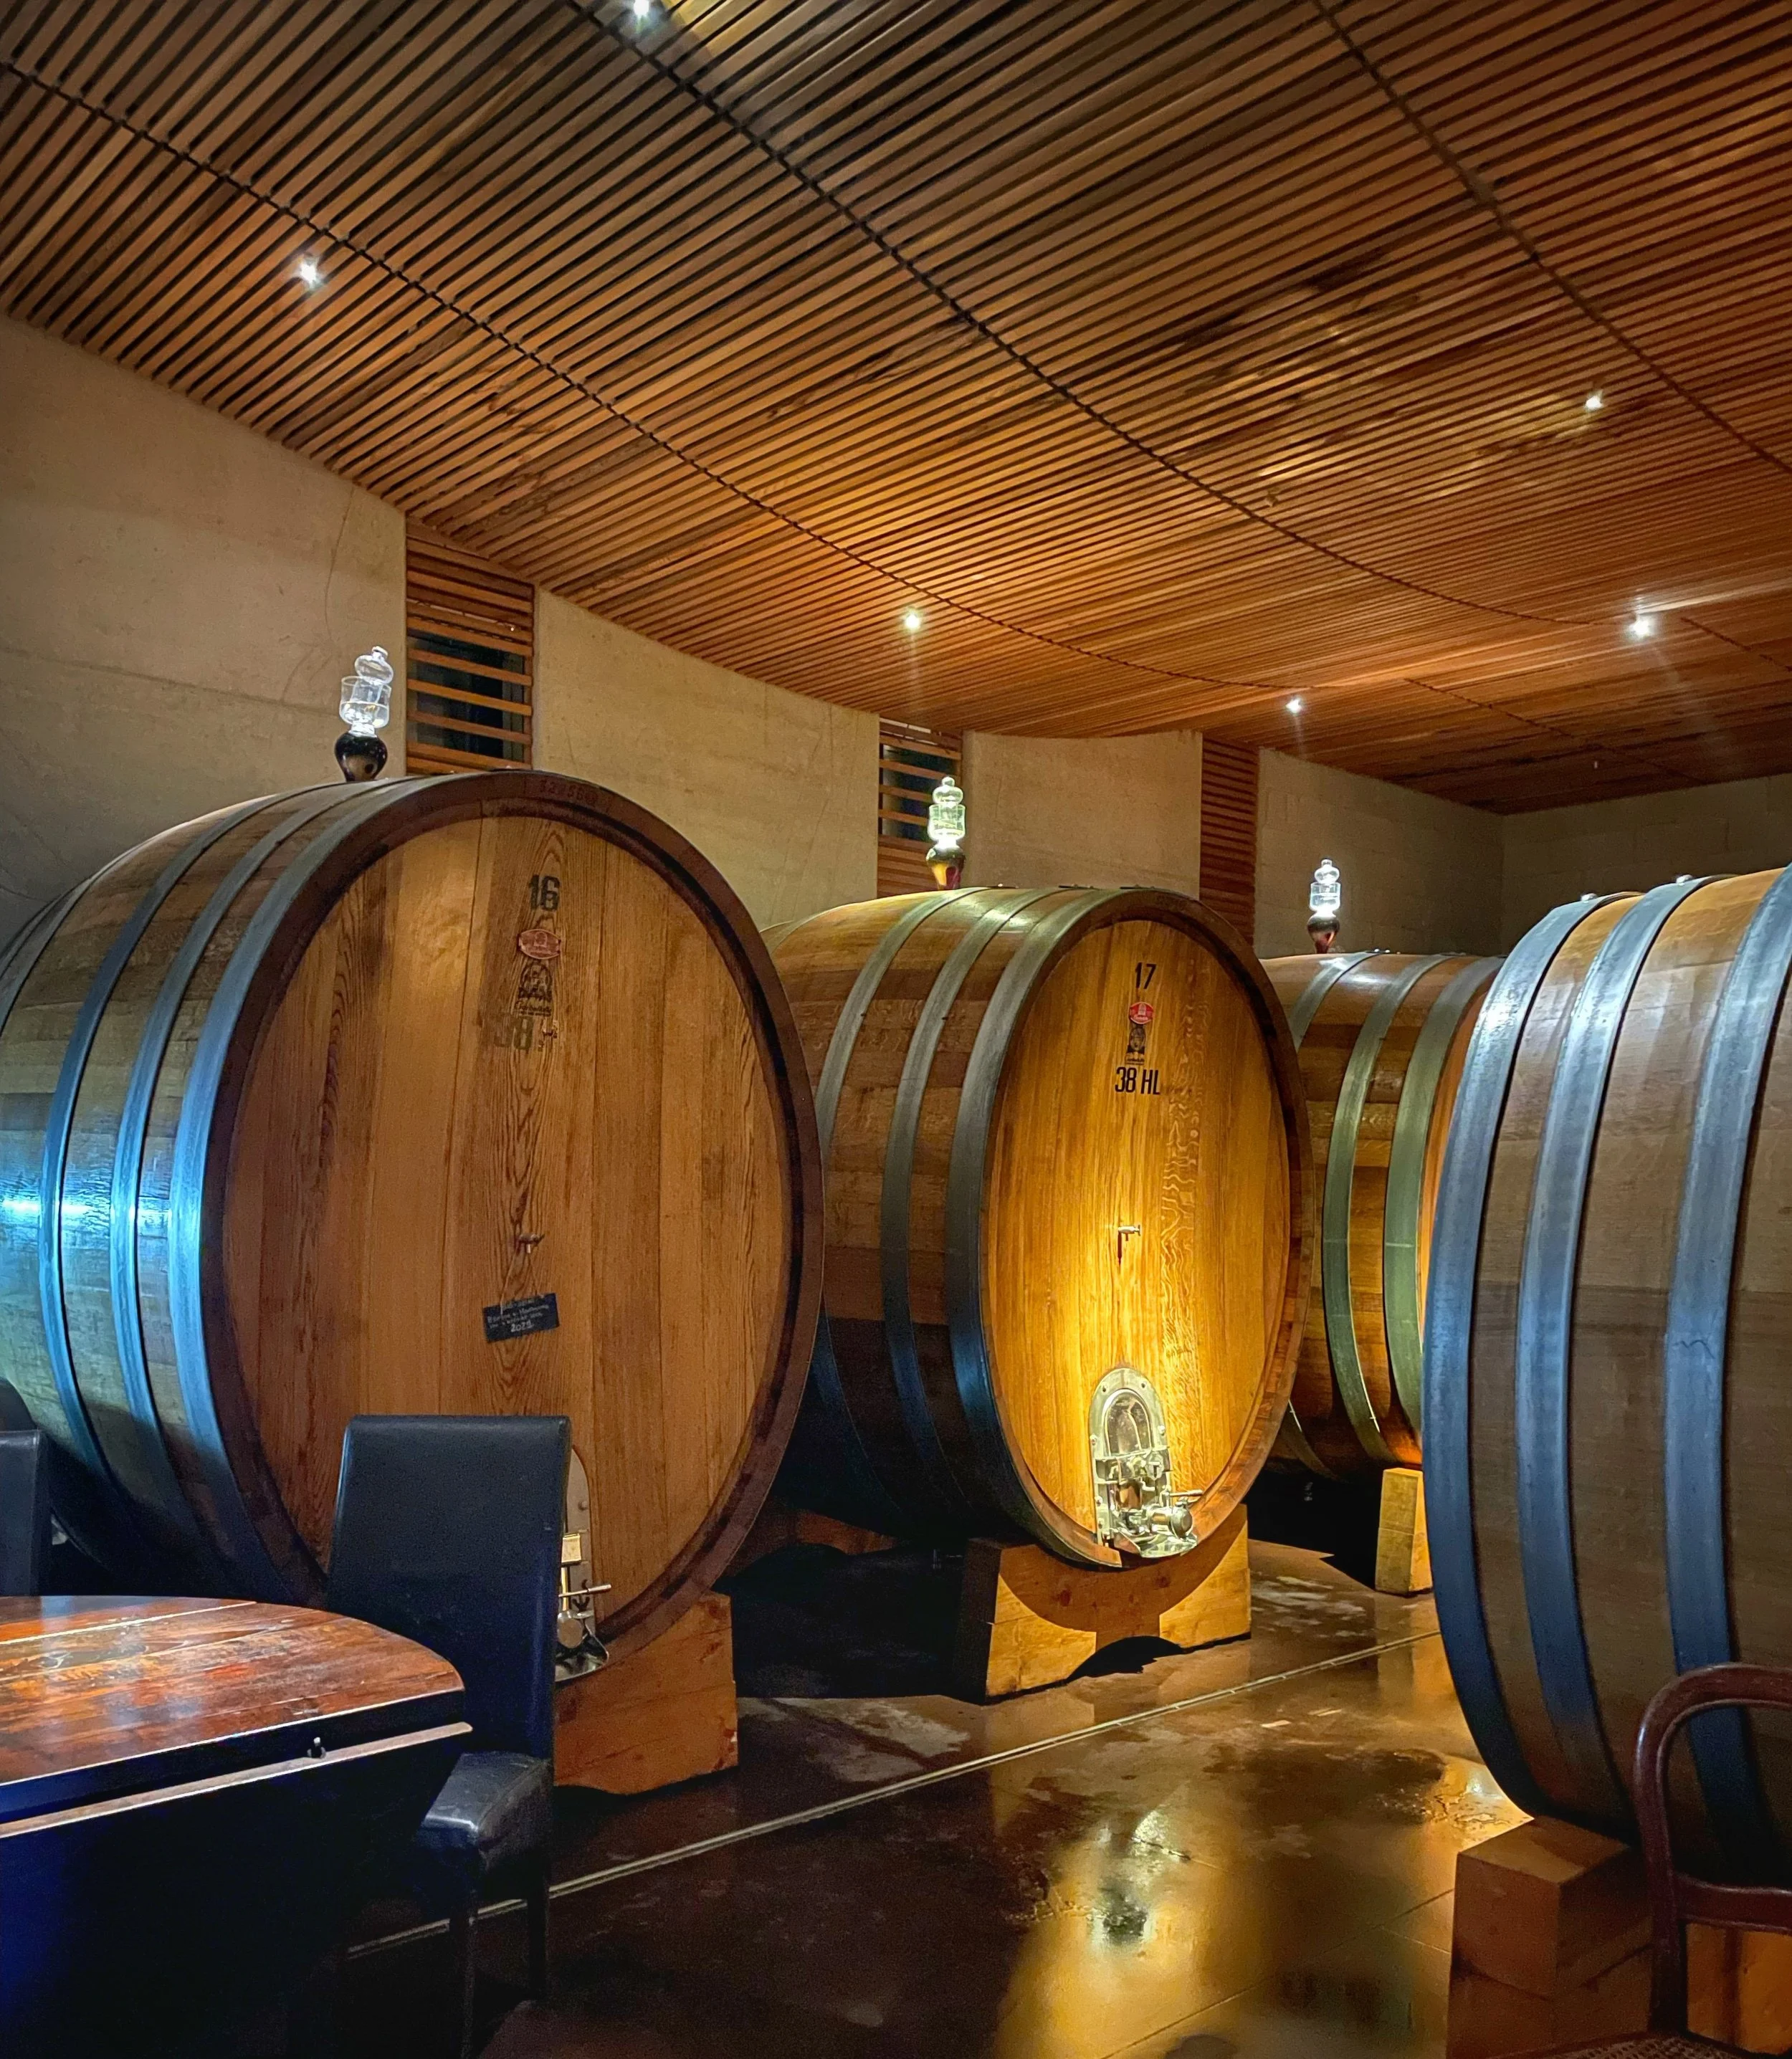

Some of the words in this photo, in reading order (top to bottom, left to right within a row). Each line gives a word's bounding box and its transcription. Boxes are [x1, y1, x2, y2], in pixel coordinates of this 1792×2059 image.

[529, 874, 560, 912] 16
[1135, 962, 1157, 990] 17
[1115, 1066, 1138, 1093] 38
[1140, 1069, 1160, 1095] HL
